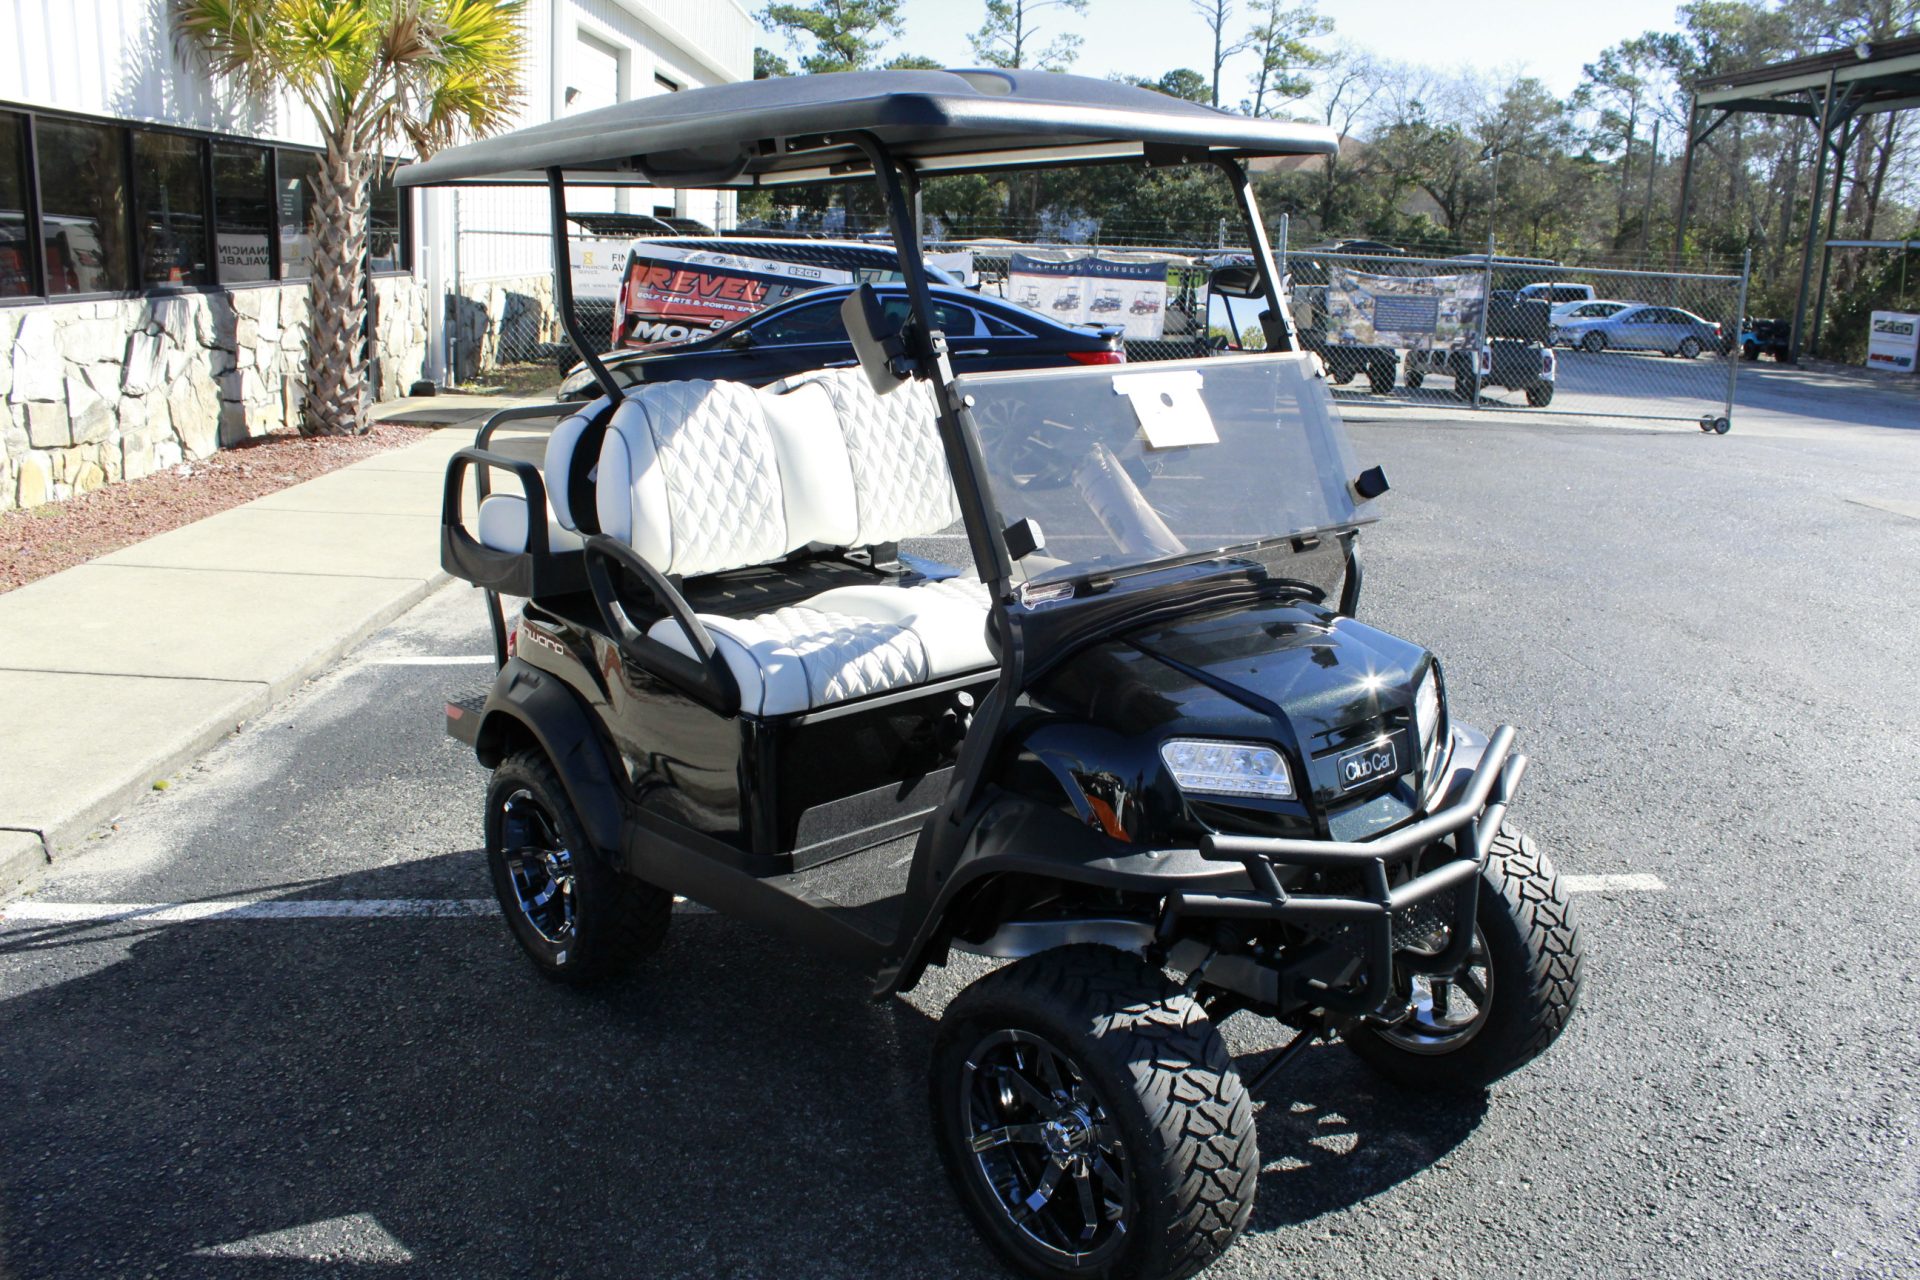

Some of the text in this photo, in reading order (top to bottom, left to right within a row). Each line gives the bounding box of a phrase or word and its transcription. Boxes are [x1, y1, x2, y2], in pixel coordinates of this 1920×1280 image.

[1028, 262, 1151, 274] EXPRESS YOURSELF
[637, 292, 660, 300] GOLF
[662, 295, 691, 305] CARTS
[703, 302, 736, 312] POWER
[1345, 753, 1391, 780] Club Car
